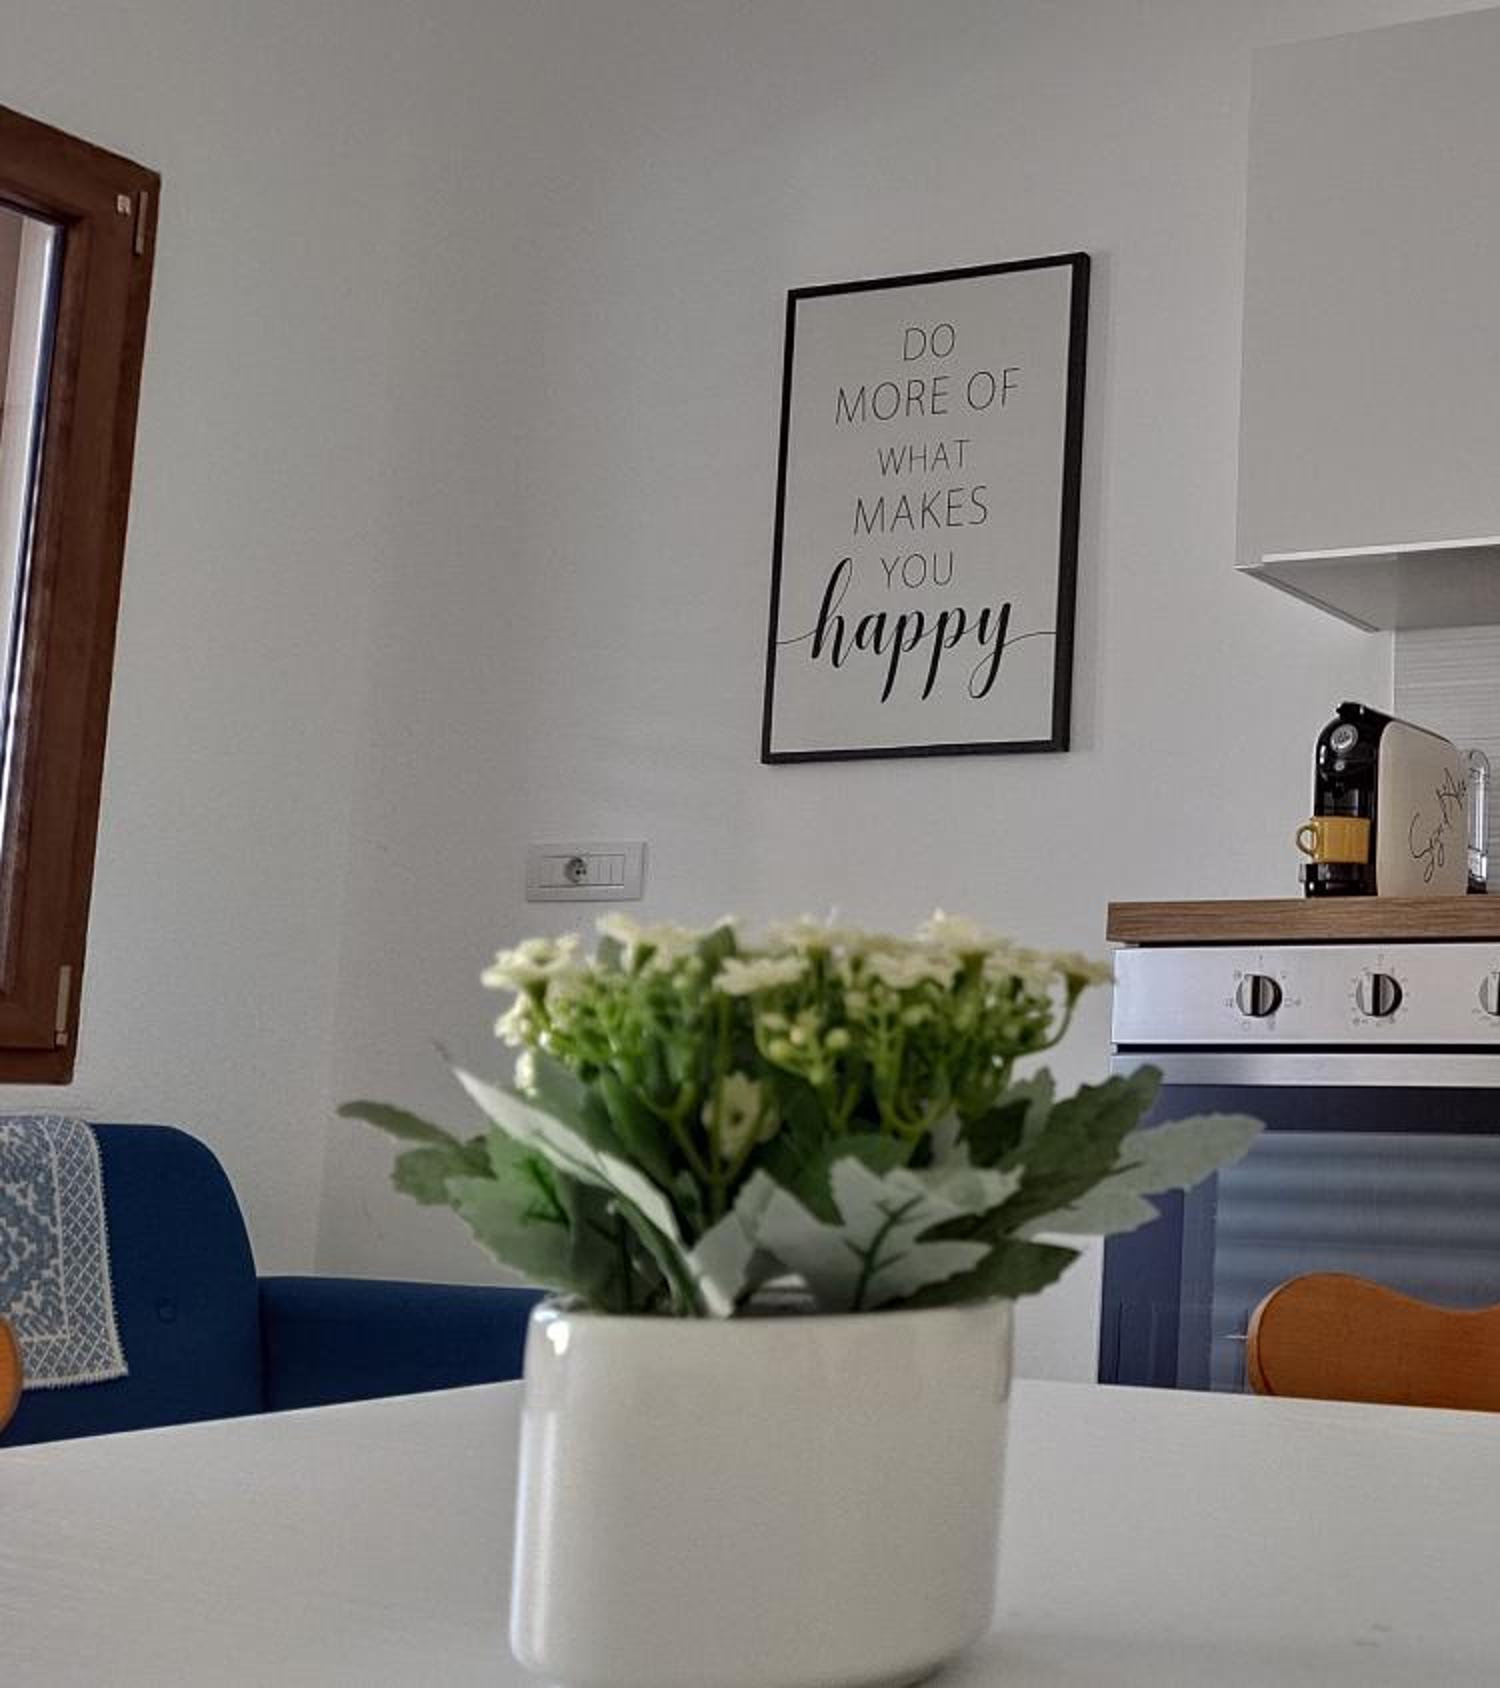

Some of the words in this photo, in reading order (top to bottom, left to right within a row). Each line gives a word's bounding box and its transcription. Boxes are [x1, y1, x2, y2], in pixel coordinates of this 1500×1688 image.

[902, 322, 957, 361] DO
[834, 375, 951, 425] MORE
[966, 367, 1021, 412] OF
[877, 439, 971, 476] WHAT
[853, 485, 989, 535] MAKES
[879, 551, 954, 590] YOU
[797, 556, 1028, 704] happy
